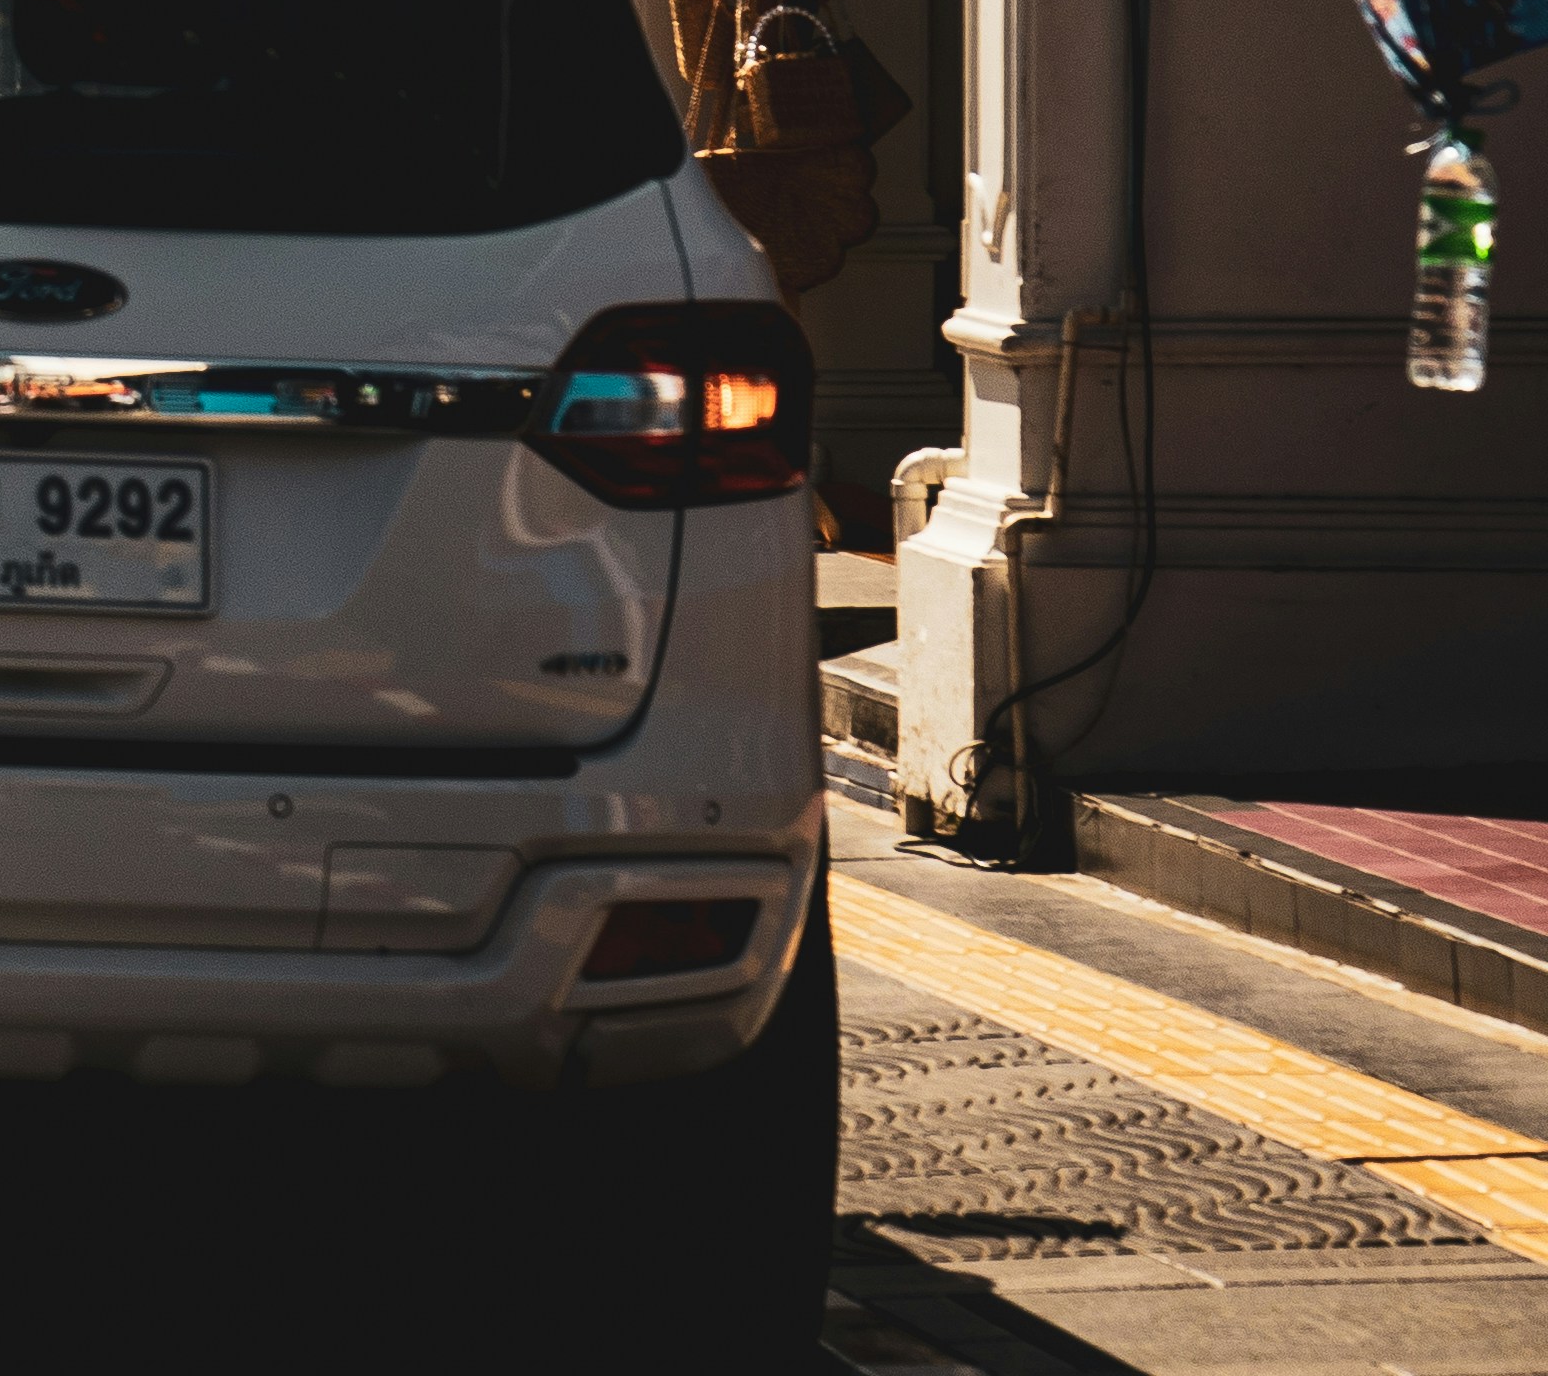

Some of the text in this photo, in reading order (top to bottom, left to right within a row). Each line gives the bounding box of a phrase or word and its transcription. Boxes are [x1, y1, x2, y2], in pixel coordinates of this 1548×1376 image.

[36, 475, 194, 542] 9292
[0, 550, 80, 598] ภูเก็ต
